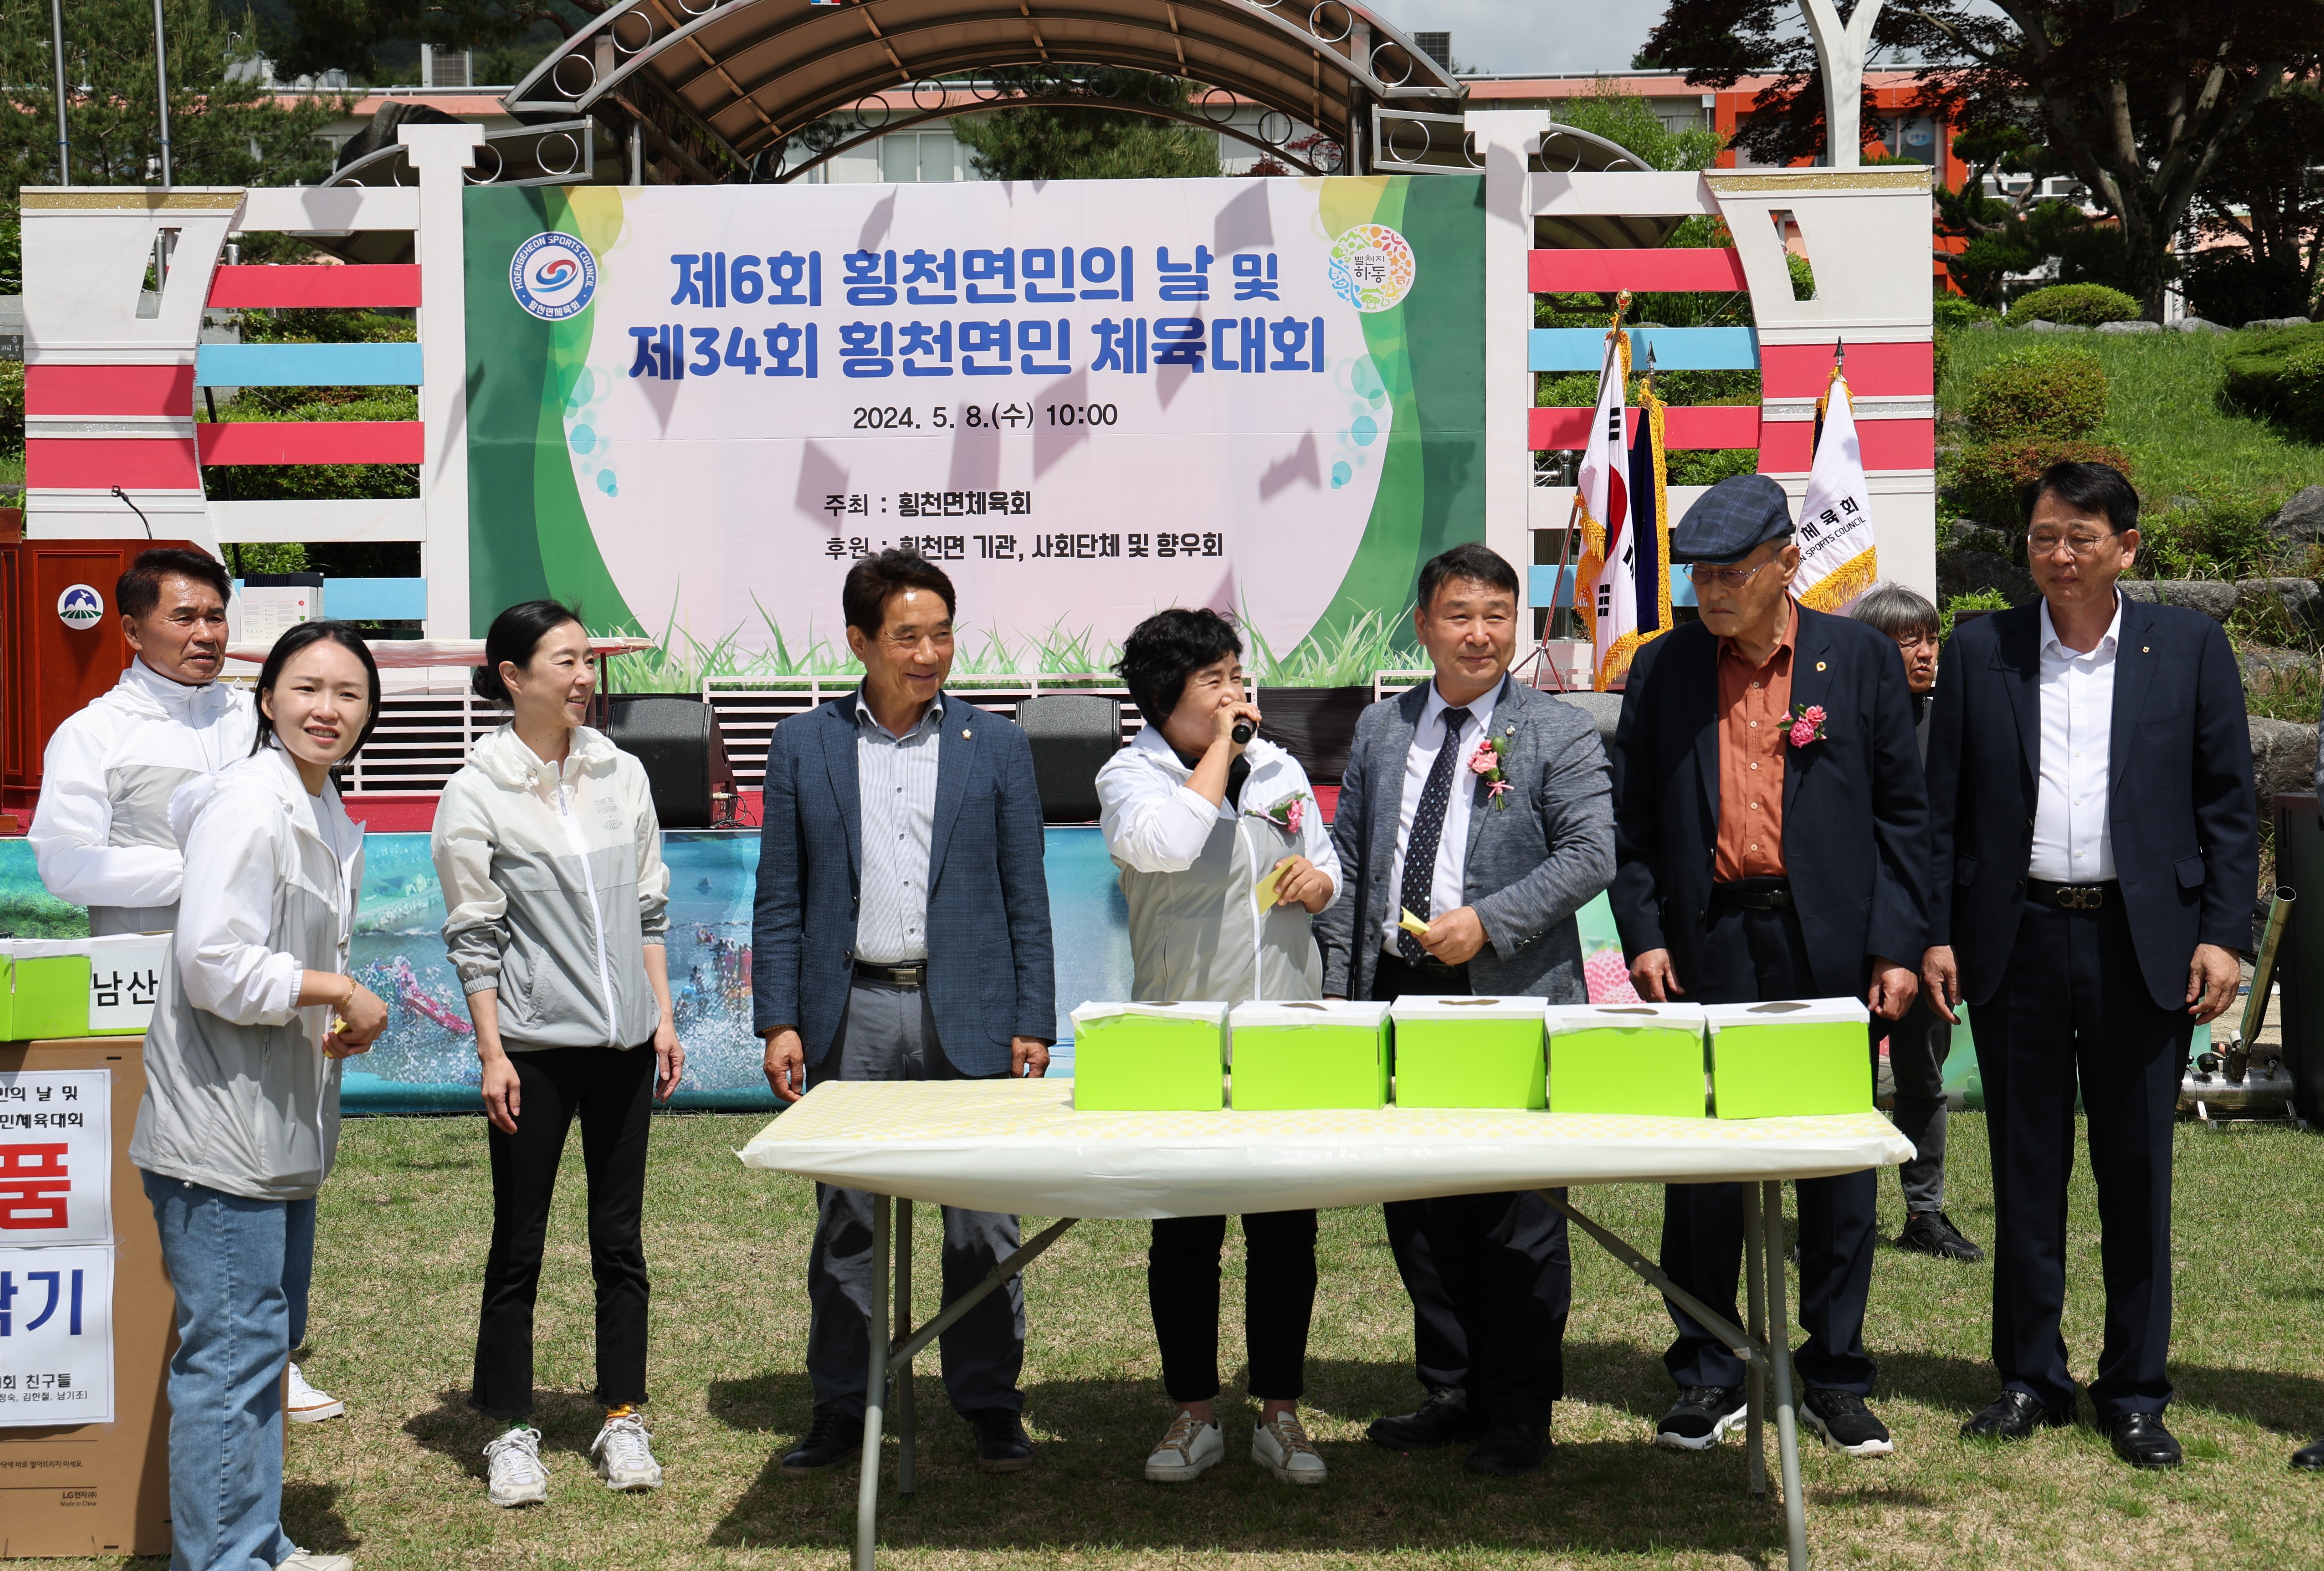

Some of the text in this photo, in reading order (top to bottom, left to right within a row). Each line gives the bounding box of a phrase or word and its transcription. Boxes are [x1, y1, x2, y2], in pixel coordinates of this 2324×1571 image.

[547, 235, 582, 253] SPORTS
[579, 251, 594, 288] COUNCIL
[1354, 254, 1385, 265] 별천지
[671, 245, 1280, 308] 제6회 횡천면민의 날 및
[1354, 266, 1386, 283] 하동
[528, 300, 581, 317] 횡천면체육회
[628, 316, 1324, 380] 제34회 횡천면민 체육대회
[853, 402, 1118, 430] 2024. 5. 8.(수) 10:00
[824, 490, 1031, 517] 주최 : 횡천면체육회
[1796, 496, 1859, 550] 체육회
[825, 537, 869, 560] 후원
[973, 535, 1024, 562] 기관,
[1032, 533, 1120, 558] 사회단체
[1128, 533, 1149, 558] 및
[1157, 532, 1223, 557] 향우회
[1805, 534, 1835, 558] SPORTS
[1834, 516, 1866, 537] COUNCIL
[597, 805, 618, 815] PERFORM
[605, 820, 621, 829] VITRO
[93, 969, 159, 1006] 남산
[36, 1086, 53, 1101] 날
[62, 1086, 78, 1100] 및
[0, 1113, 83, 1129] 민체육대회
[0, 1143, 71, 1229] 품
[0, 1373, 71, 1389] 회 친구들
[23, 1392, 52, 1401] 김한철,
[30, 1460, 61, 1469] 떨어뜨리지
